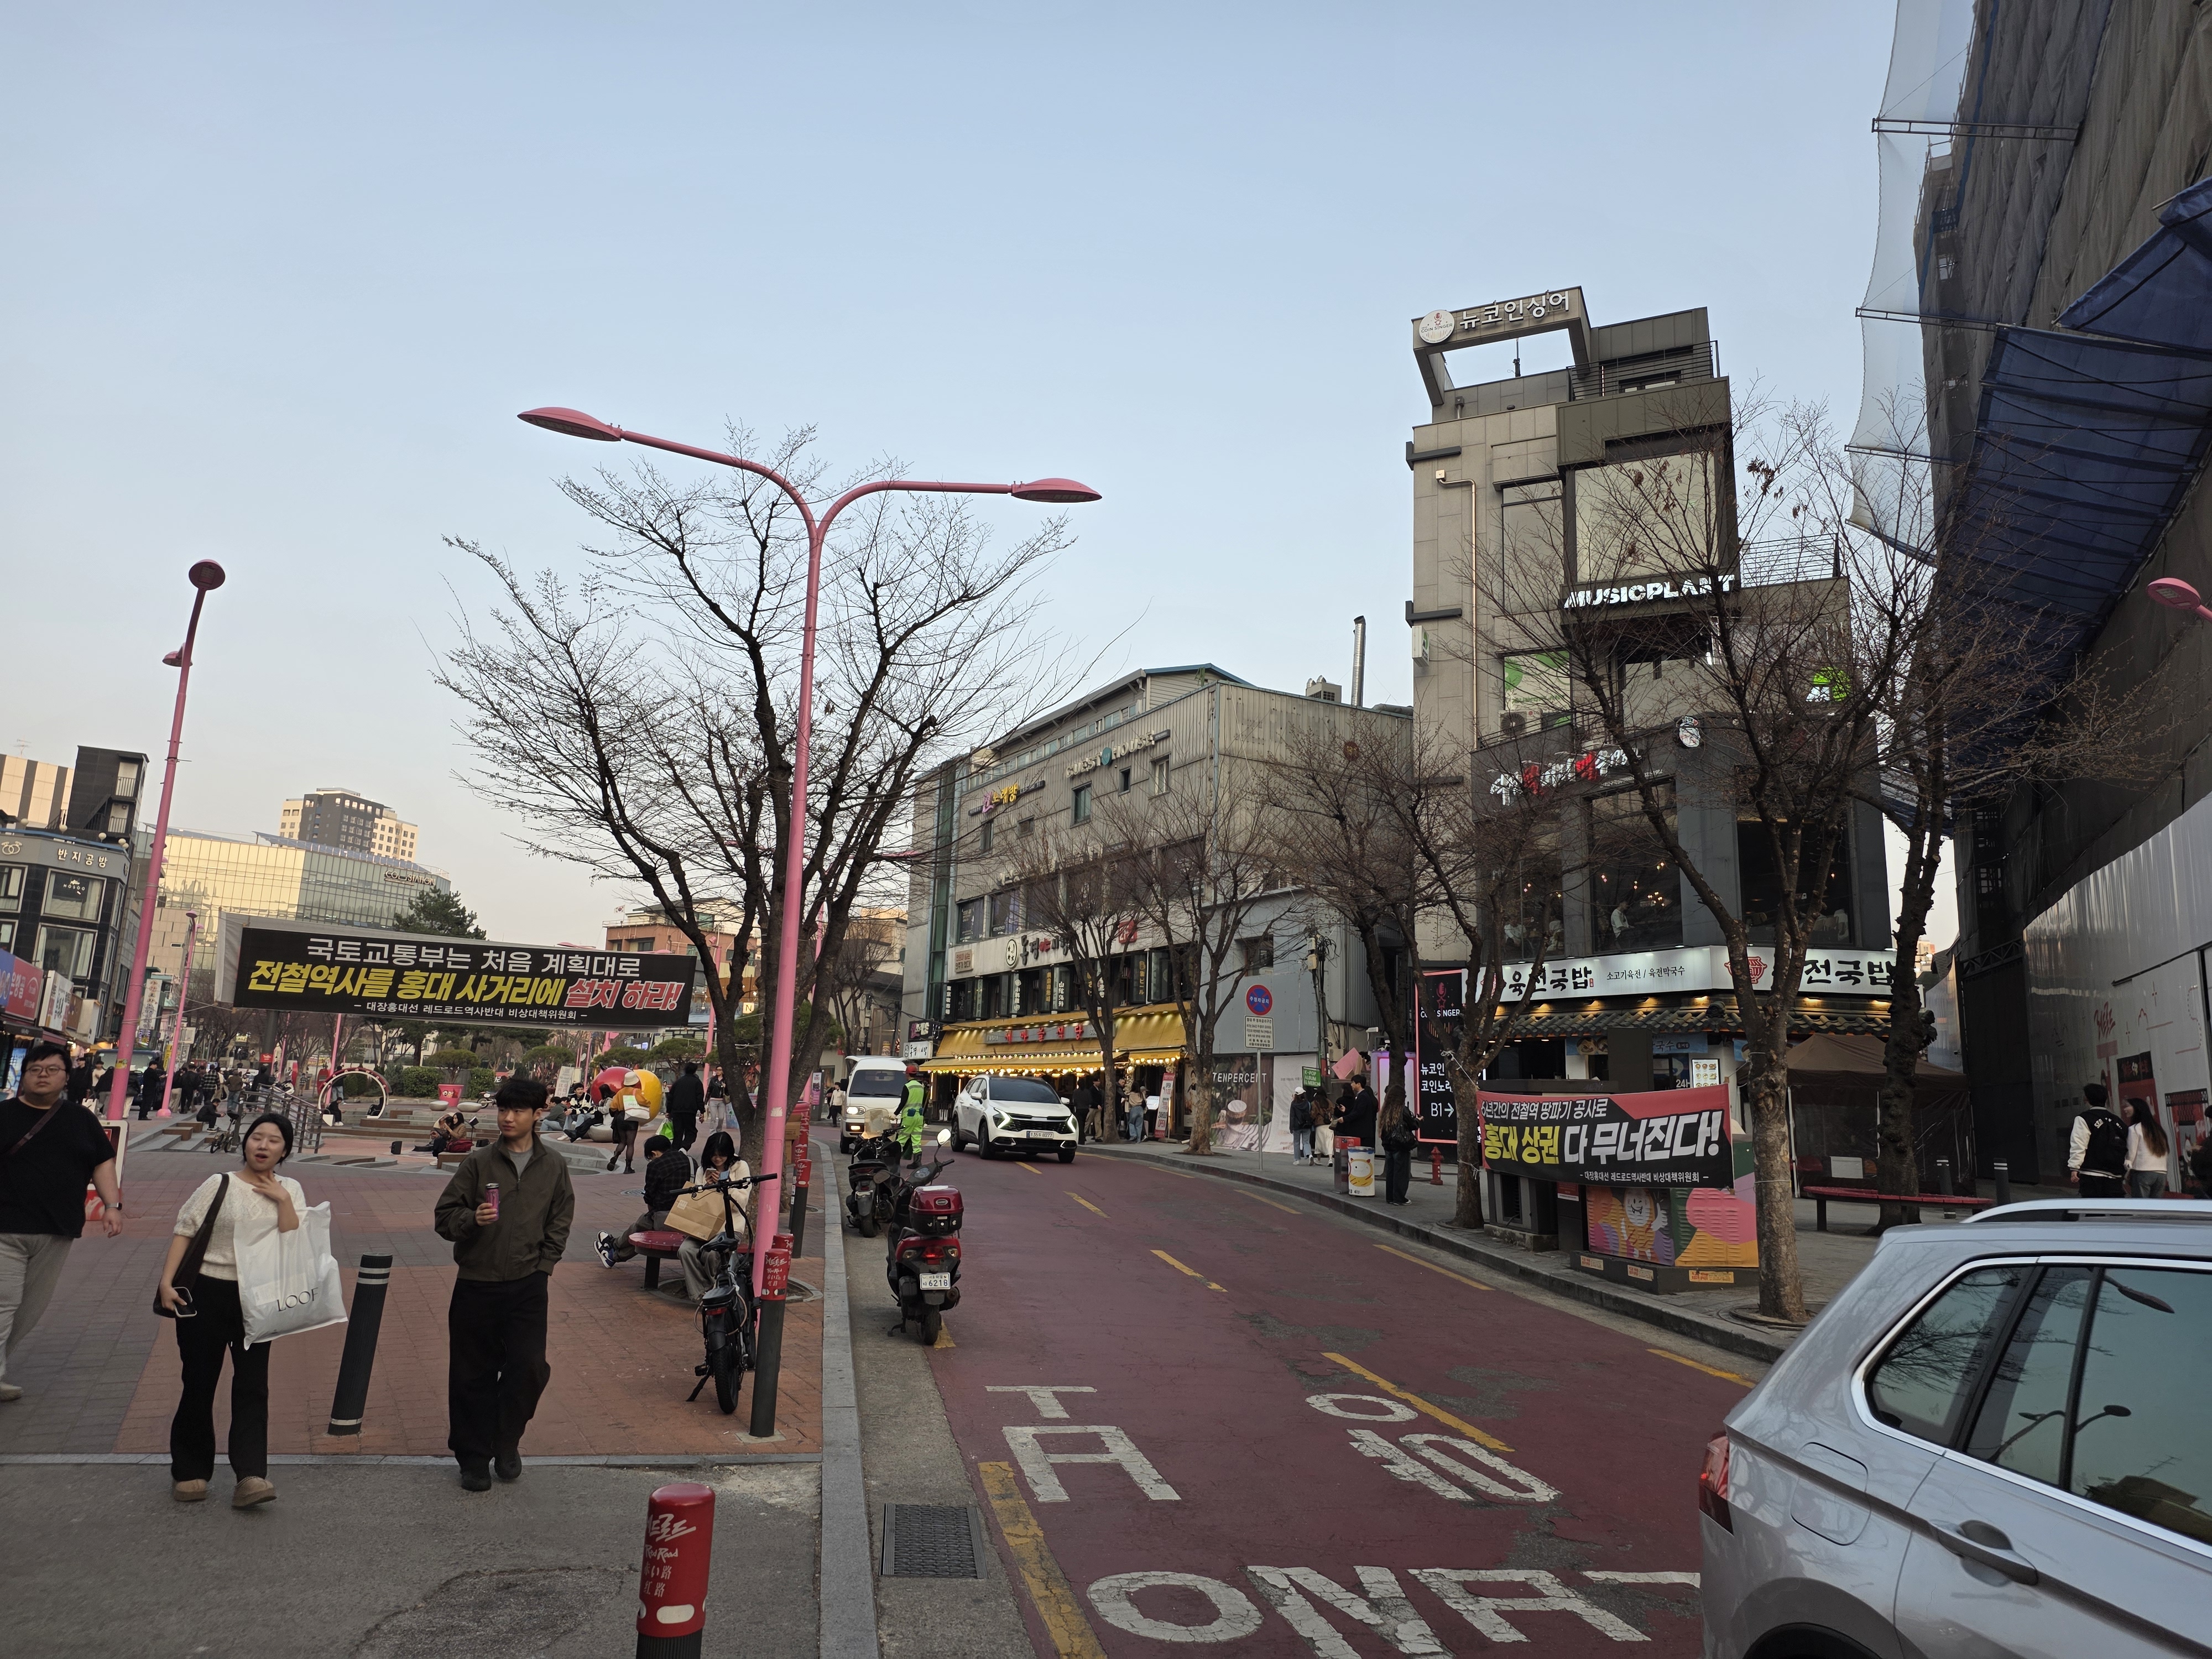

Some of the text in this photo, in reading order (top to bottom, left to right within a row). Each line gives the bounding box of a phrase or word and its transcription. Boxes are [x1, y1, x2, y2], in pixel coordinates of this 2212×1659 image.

[1460, 291, 1569, 330] 뉴코인싱어
[1066, 729, 1155, 779] GUEST HOUSE
[58, 848, 107, 868] 반지공방
[307, 937, 640, 978] 국토교통부는 처음 계획대로
[1509, 966, 1592, 996] 육전국밥
[1606, 968, 1641, 980] 소고기육전
[1648, 965, 1686, 978] 육전막국수
[247, 959, 685, 1011] 전철역사를 홍대 사거리에 설치 하라!
[366, 1001, 577, 1020] 대장홍대선 레드로드역사반대 비상대책위원회
[1250, 996, 1269, 1004] 주정차금지
[1005, 1022, 1084, 1044] 새마을식당
[1431, 1102, 1442, 1117] B1
[1480, 1098, 1608, 1120] 6년간의 전철역 땅파기 공사로
[1484, 1110, 1723, 1165] 홍대 상권 다 무너진다!
[1584, 1171, 1699, 1183] 대장홍대선 레드로드역사반대 비상대책위원회
[277, 1287, 318, 1312] LOOF
[657, 1548, 678, 1563] Road
